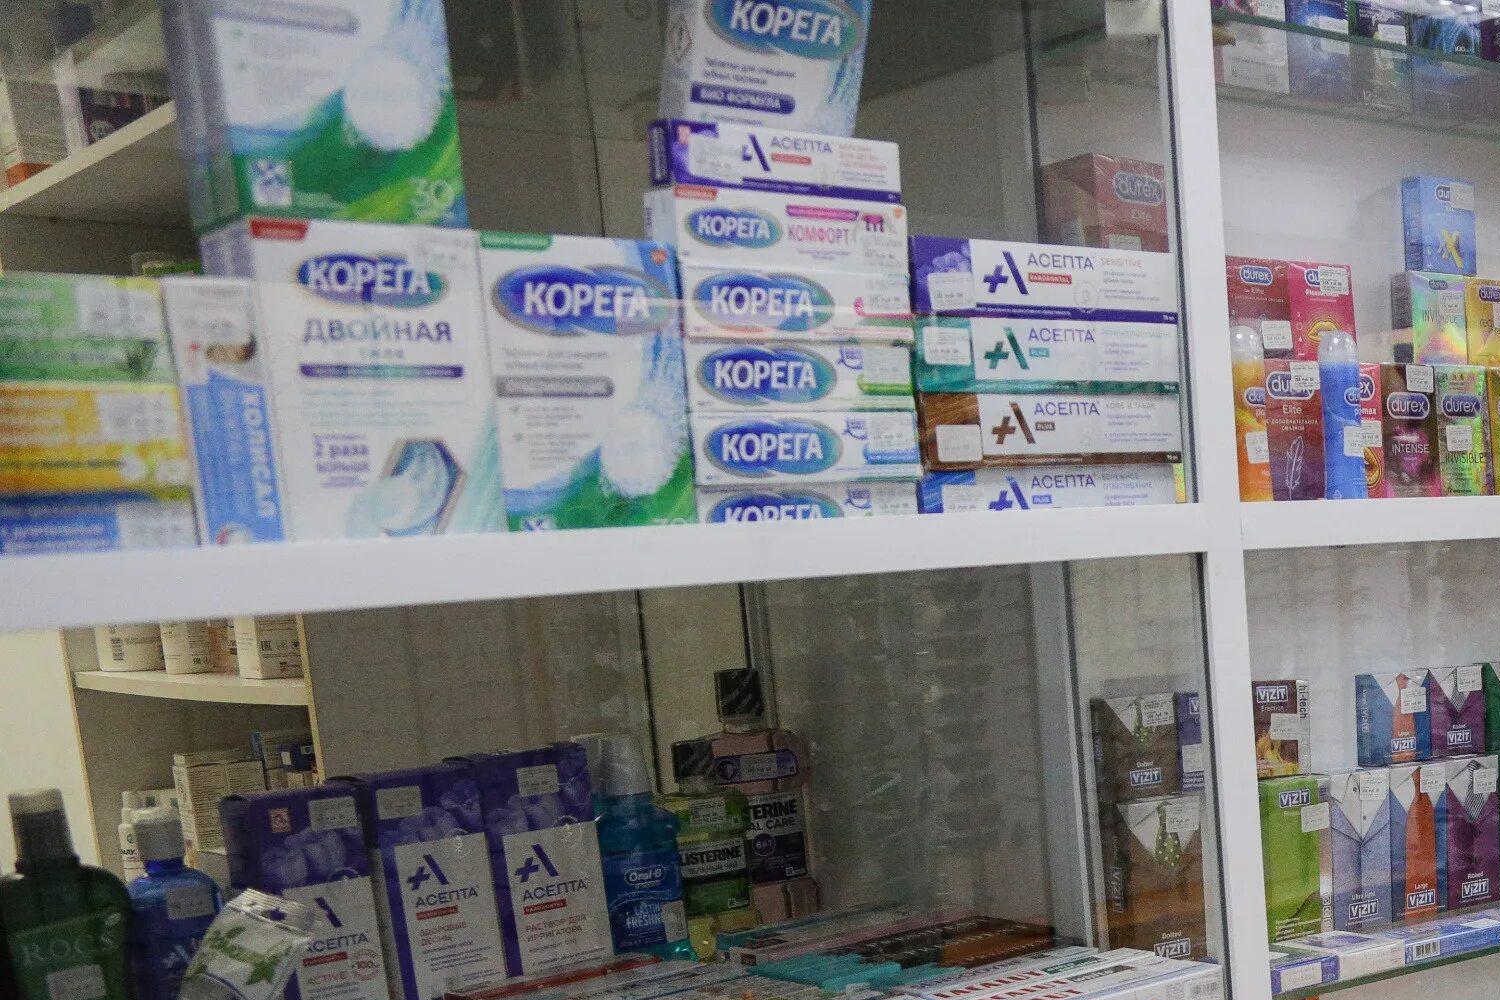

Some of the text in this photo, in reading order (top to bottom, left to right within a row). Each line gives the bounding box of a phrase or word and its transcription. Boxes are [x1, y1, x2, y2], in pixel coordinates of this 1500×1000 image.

[731, 0, 841, 46] КОРЕГА
[770, 136, 833, 154] АСЕПТА
[1117, 178, 1160, 201] durex
[699, 215, 850, 245] КОРЕГА КОМФОРТ
[1027, 252, 1094, 270] АСЕПТА
[306, 261, 431, 295] КОРЕГА
[1241, 266, 1271, 284] durex
[523, 282, 650, 318] КОРЕГА
[711, 286, 814, 317] КОРЕГА
[303, 316, 452, 343] ДВОЙНАЯ
[1028, 327, 1095, 343] АСЕПТА
[714, 360, 817, 390] КОРЕГА
[1034, 401, 1099, 416] АСЕПТА
[1282, 404, 1303, 415] Elite
[1391, 393, 1427, 412] durex
[1445, 395, 1479, 412] durex
[722, 432, 823, 461] КОРЕГА
[1391, 443, 1430, 454] INTENSE
[1445, 453, 1485, 464] INVISIBLE
[1031, 474, 1095, 489] АСЕПТА
[415, 887, 479, 908] АСЕПТА
[523, 880, 588, 901] АСЕПТА
